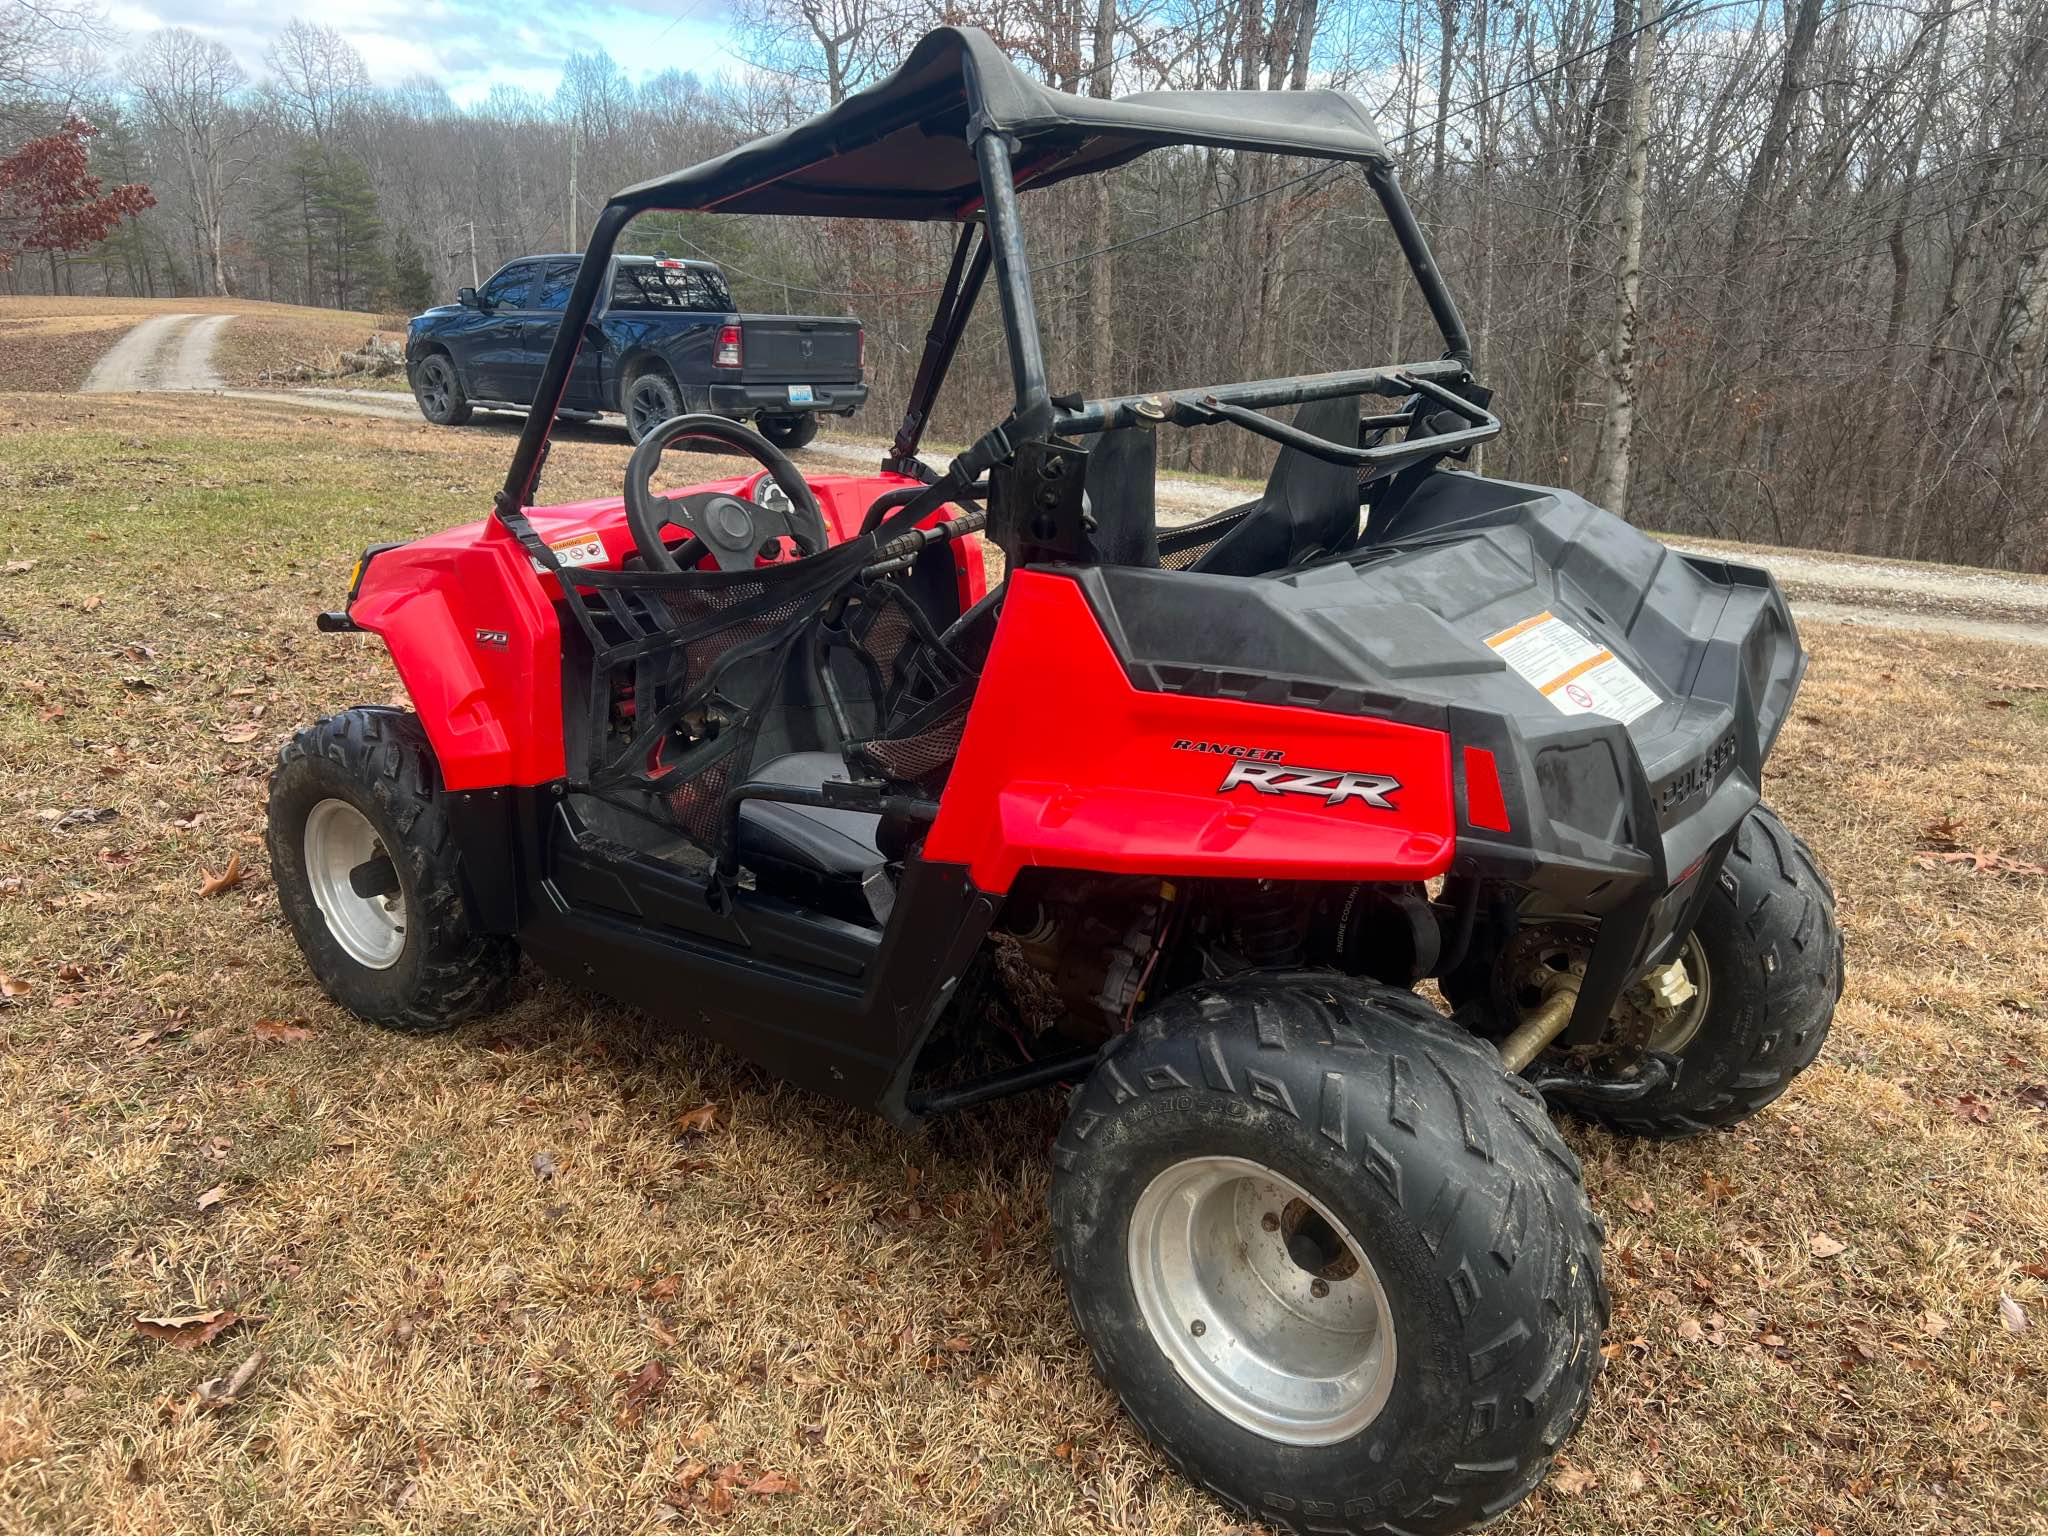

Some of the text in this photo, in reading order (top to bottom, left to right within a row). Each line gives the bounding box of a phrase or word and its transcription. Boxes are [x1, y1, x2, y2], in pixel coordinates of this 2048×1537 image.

[552, 538, 582, 551] WARNING
[475, 628, 509, 646] 170
[1172, 738, 1286, 762] RANGER
[1217, 759, 1402, 811] RZR
[1661, 735, 1730, 815] POLARIS
[1336, 922, 1346, 952] ENGINE
